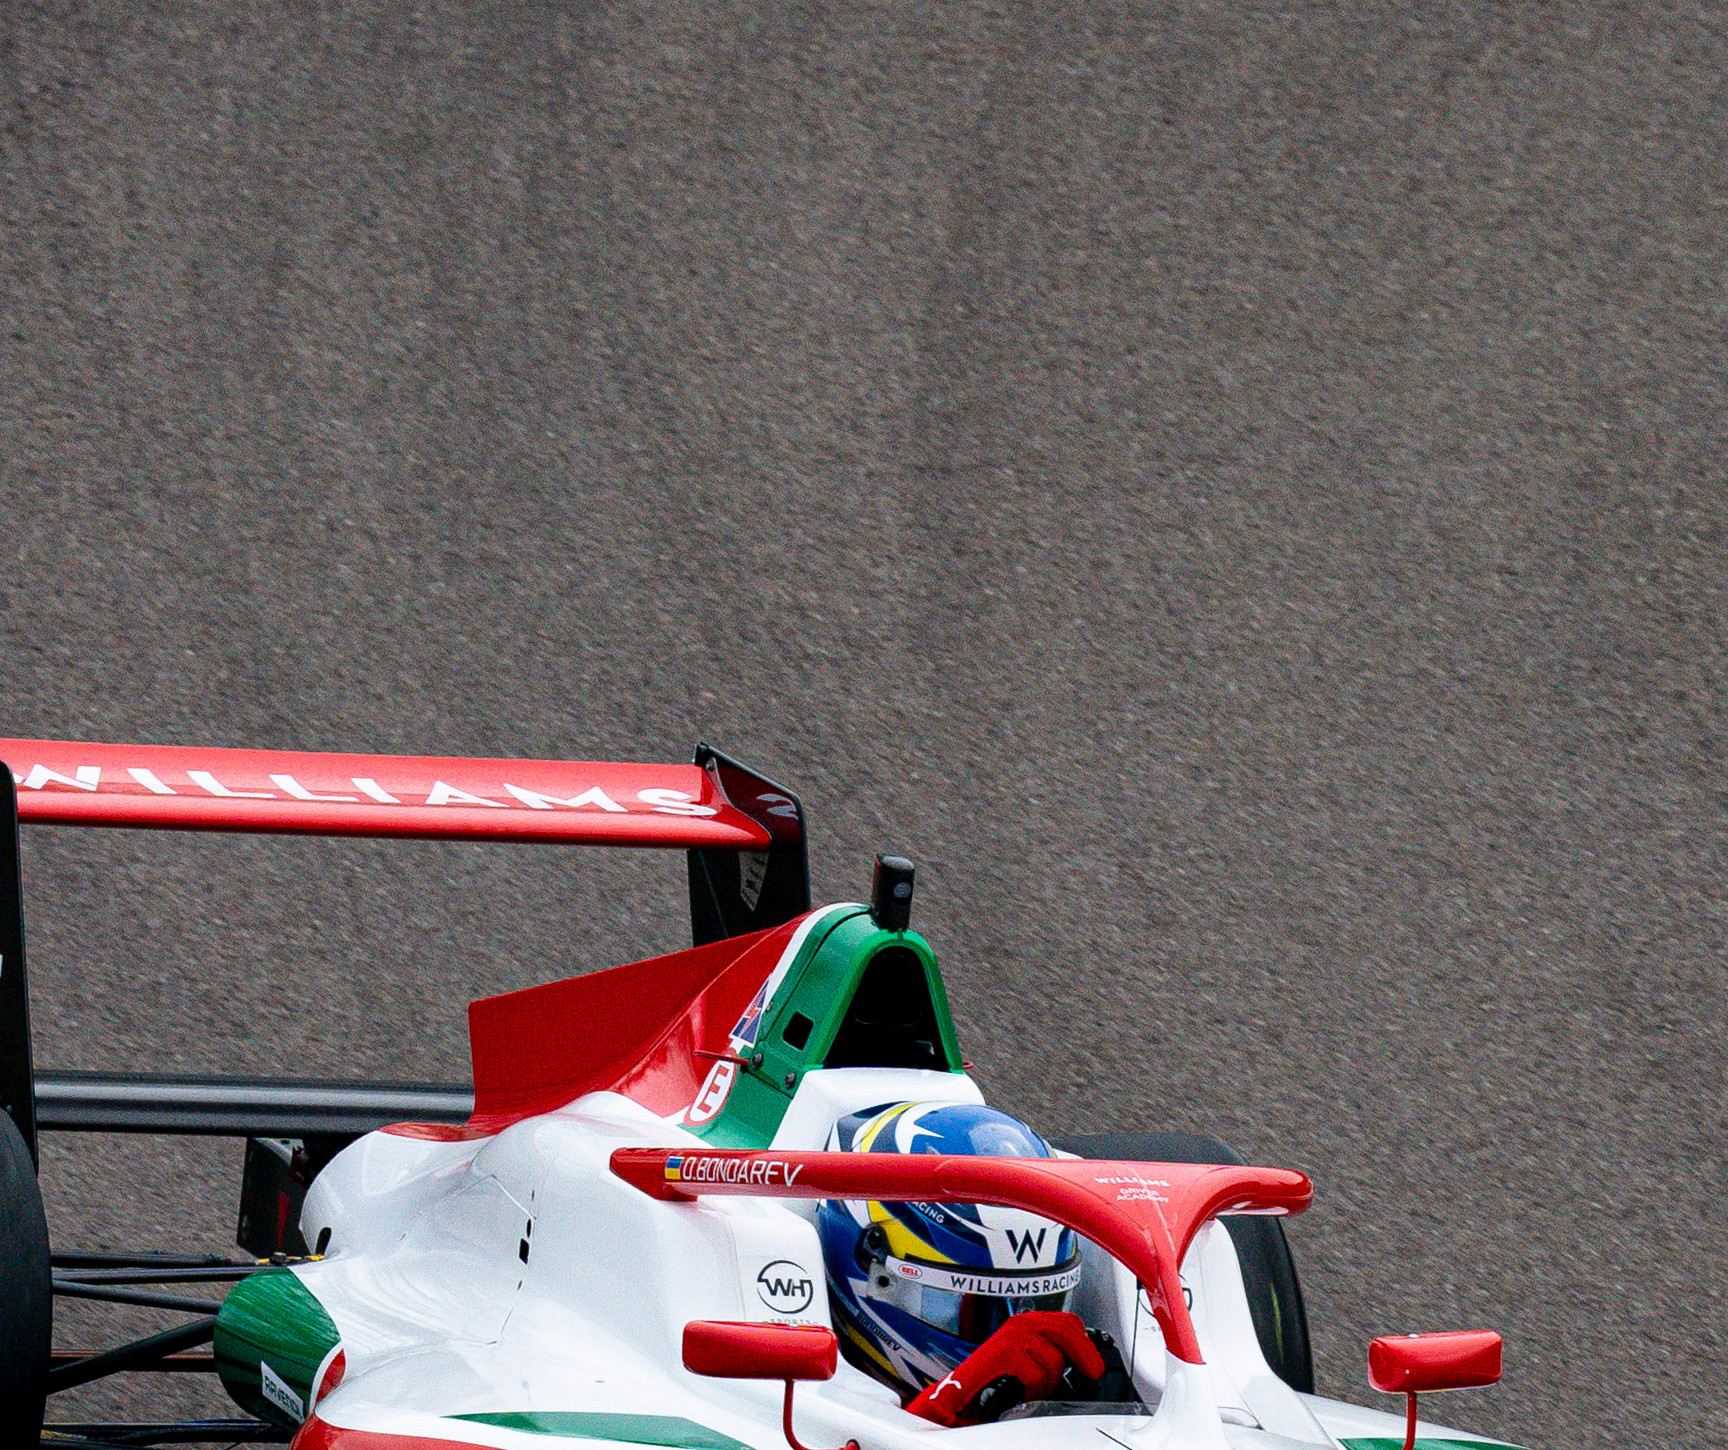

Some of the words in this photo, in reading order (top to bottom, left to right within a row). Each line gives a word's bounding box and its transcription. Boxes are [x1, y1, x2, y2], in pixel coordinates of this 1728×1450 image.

[12, 763, 718, 816] WILLIAMS
[1094, 1176, 1170, 1187] WILLIAMS
[1005, 1228, 1047, 1264] W
